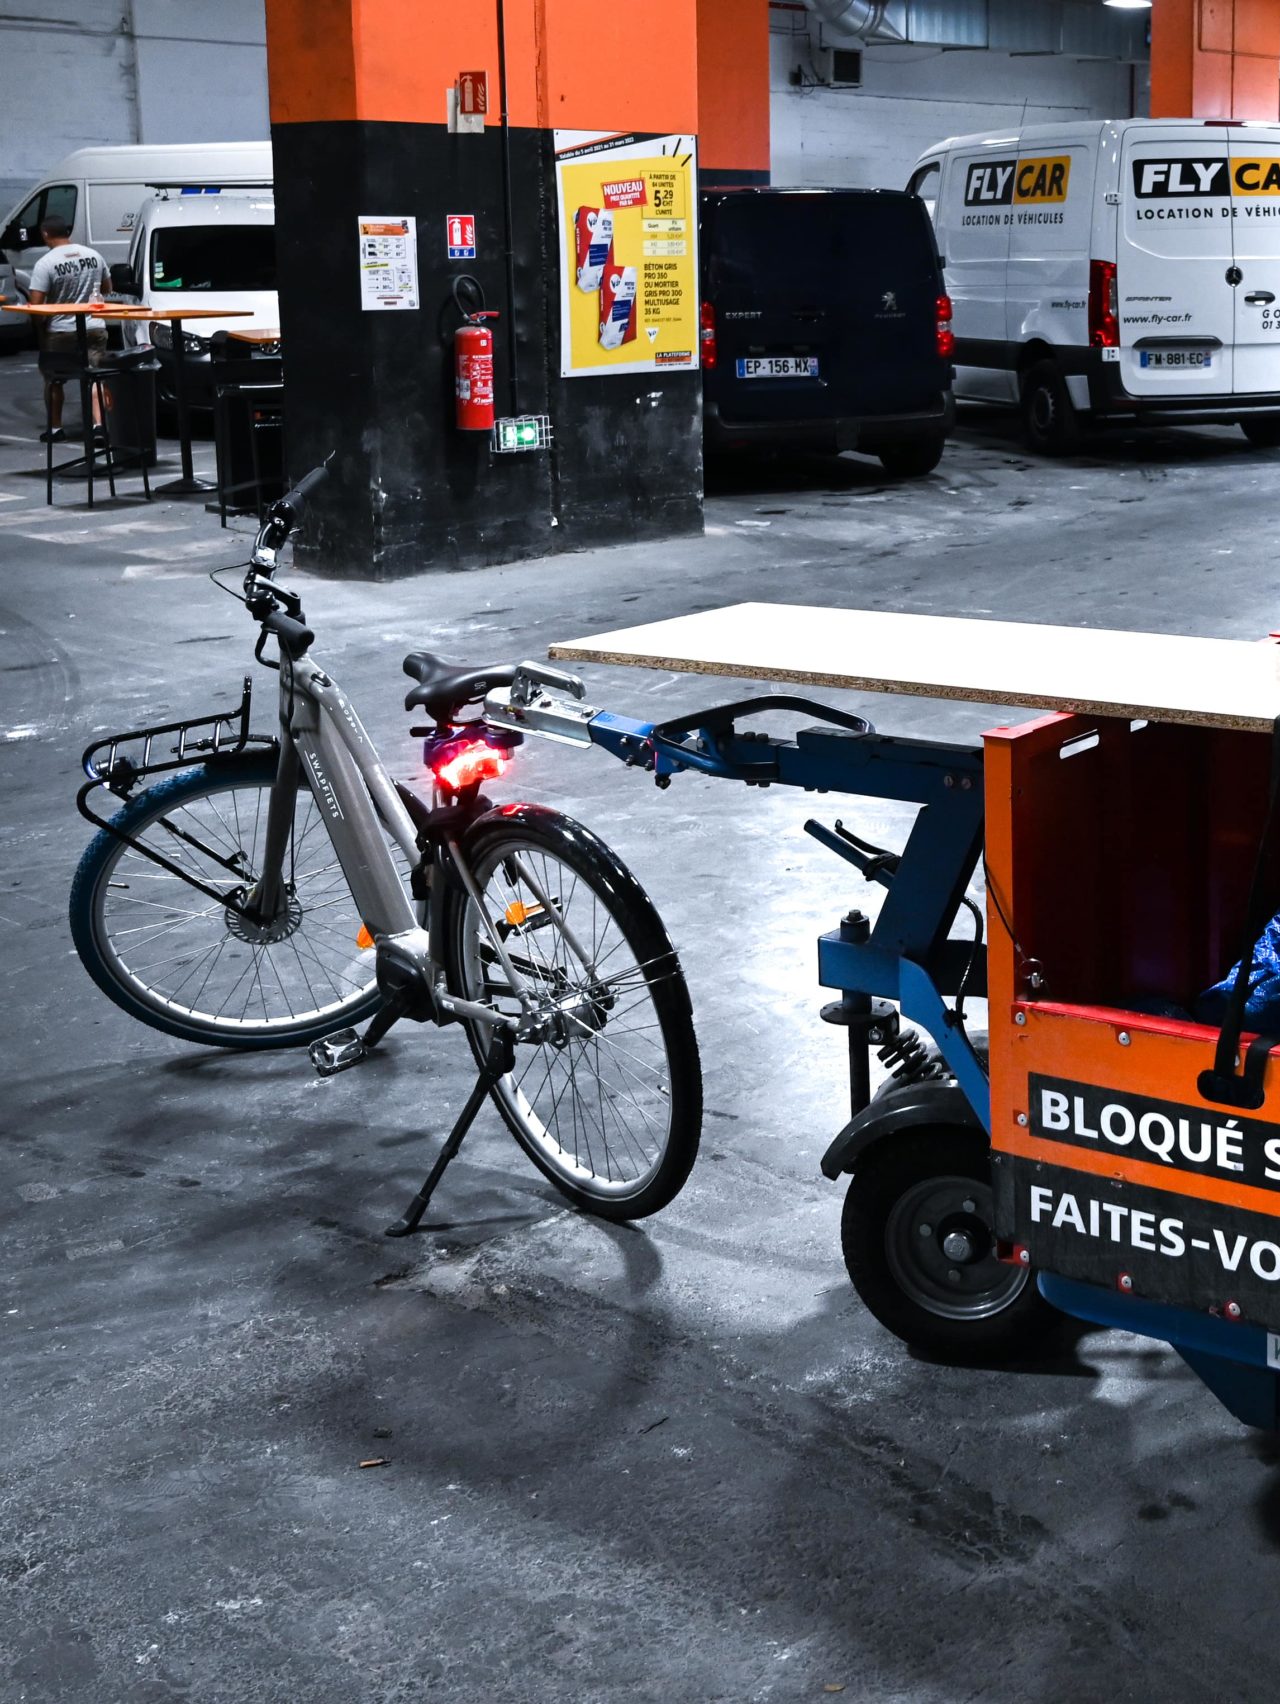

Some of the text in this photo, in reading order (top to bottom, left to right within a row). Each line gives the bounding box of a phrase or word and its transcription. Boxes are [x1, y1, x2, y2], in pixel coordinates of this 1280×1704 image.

[967, 163, 1066, 201] FLY CAR
[1140, 162, 1224, 194] FLY
[603, 181, 643, 196] NOUVEAU
[962, 210, 1064, 226] LOCATION DE VÉHICULES
[1136, 207, 1213, 220] LOCATION
[1221, 206, 1238, 218] DE
[54, 256, 98, 277] 100% PRO
[644, 262, 663, 270] BÉTON
[654, 280, 679, 288] MORTIER
[671, 289, 682, 297] 300
[652, 307, 660, 315] KG
[725, 311, 763, 320] EXPERT
[1123, 313, 1192, 325] www.fly-car.fr
[1262, 320, 1273, 330] 01
[309, 752, 339, 818] SWAPFIETS
[1041, 1088, 1244, 1172] BLOQUÉ
